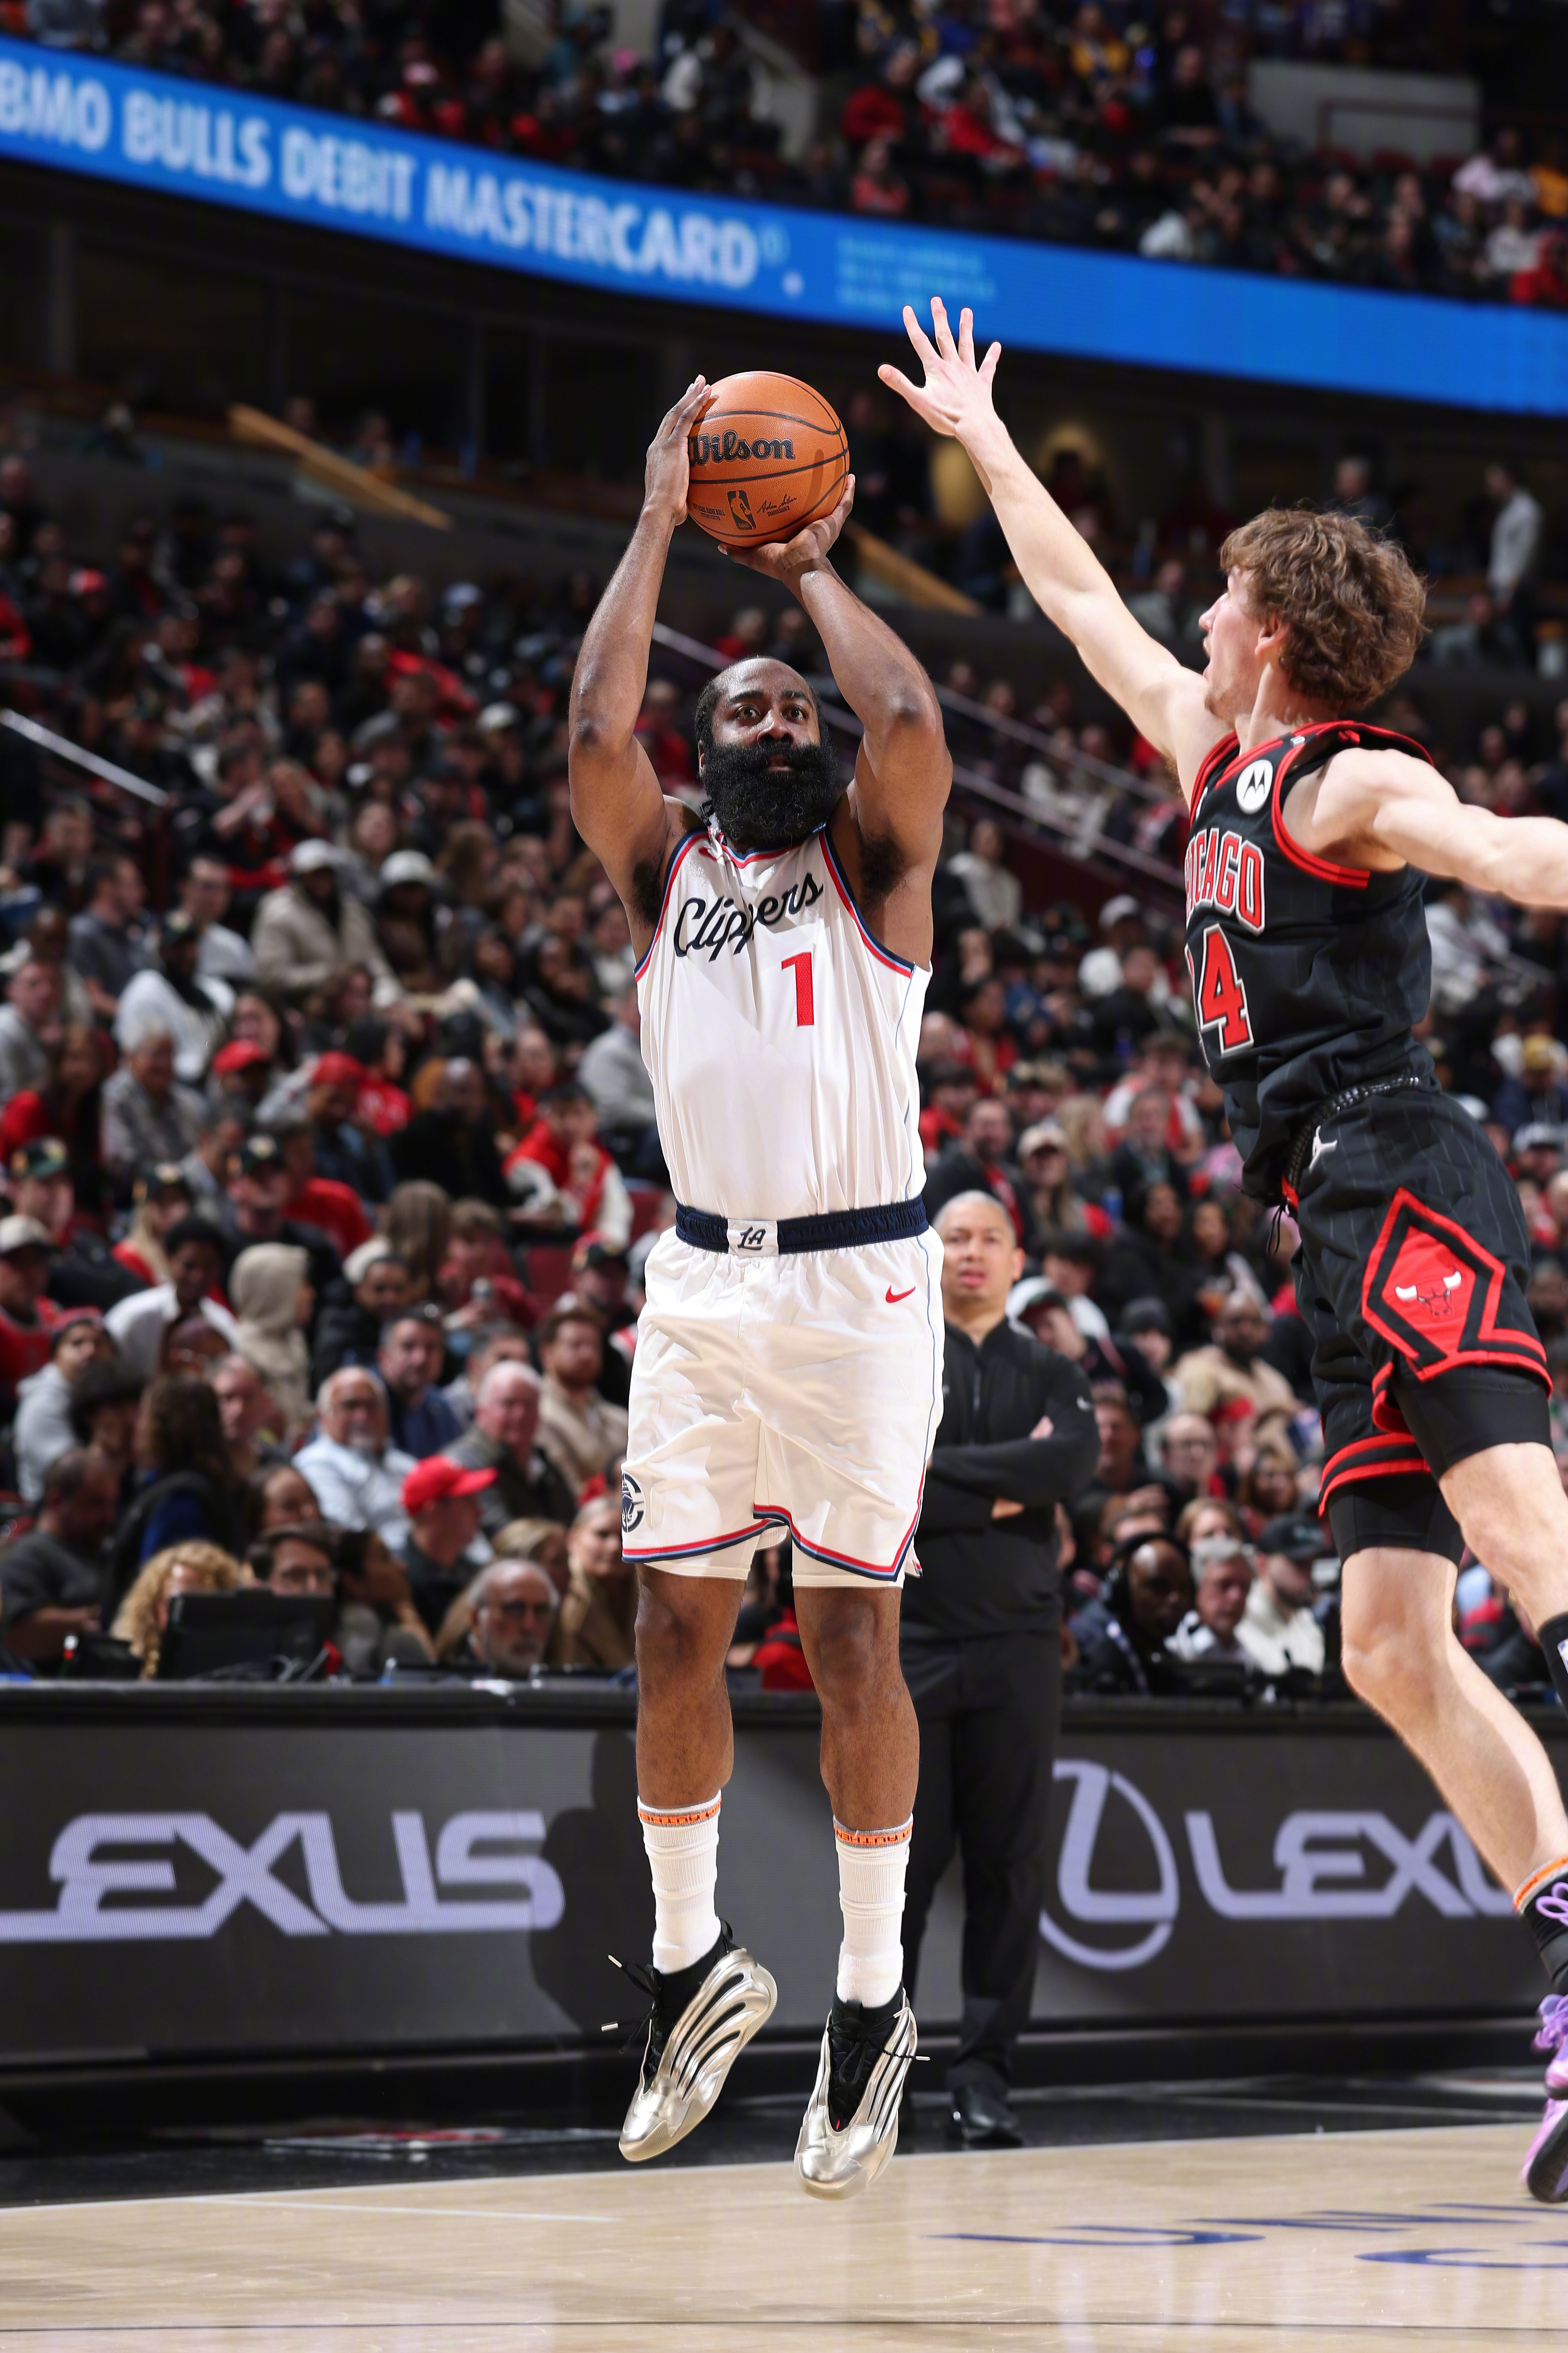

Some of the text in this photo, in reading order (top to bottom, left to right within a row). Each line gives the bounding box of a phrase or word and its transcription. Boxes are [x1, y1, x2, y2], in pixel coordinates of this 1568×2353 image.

[0, 61, 112, 152] BMO
[123, 89, 272, 188] BULLS
[281, 127, 415, 222] DEBIT
[688, 430, 795, 467] Wilson
[673, 873, 824, 962] Clippers
[1184, 827, 1265, 936] HICAGO
[781, 951, 814, 1027] 1
[1184, 923, 1254, 1057] 4
[0, 1810, 565, 1942] EXUS
